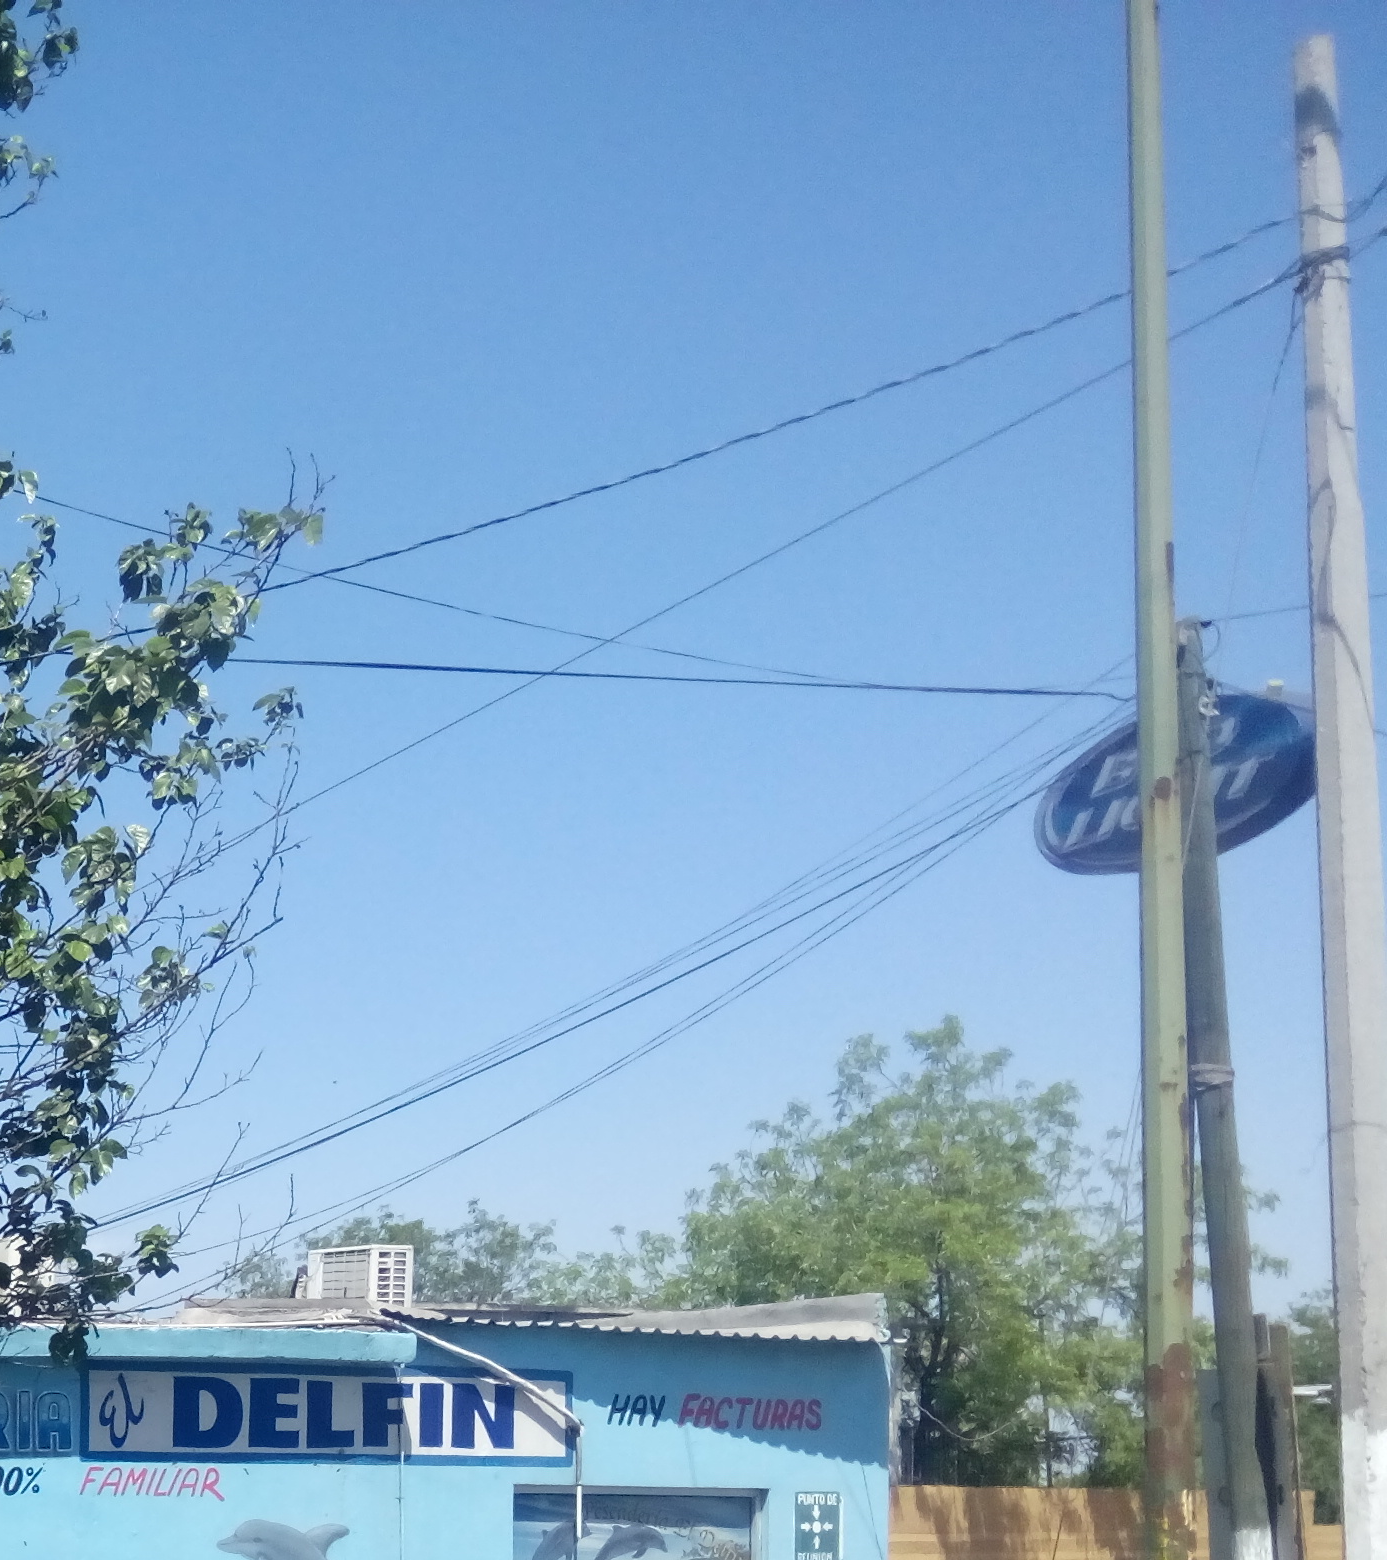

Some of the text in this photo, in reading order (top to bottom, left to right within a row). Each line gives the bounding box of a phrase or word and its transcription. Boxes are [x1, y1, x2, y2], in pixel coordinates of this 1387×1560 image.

[172, 1375, 516, 1450] DELFIN
[606, 1392, 822, 1432] HAY FACTURAS
[79, 1465, 225, 1502] FAMILIAR
